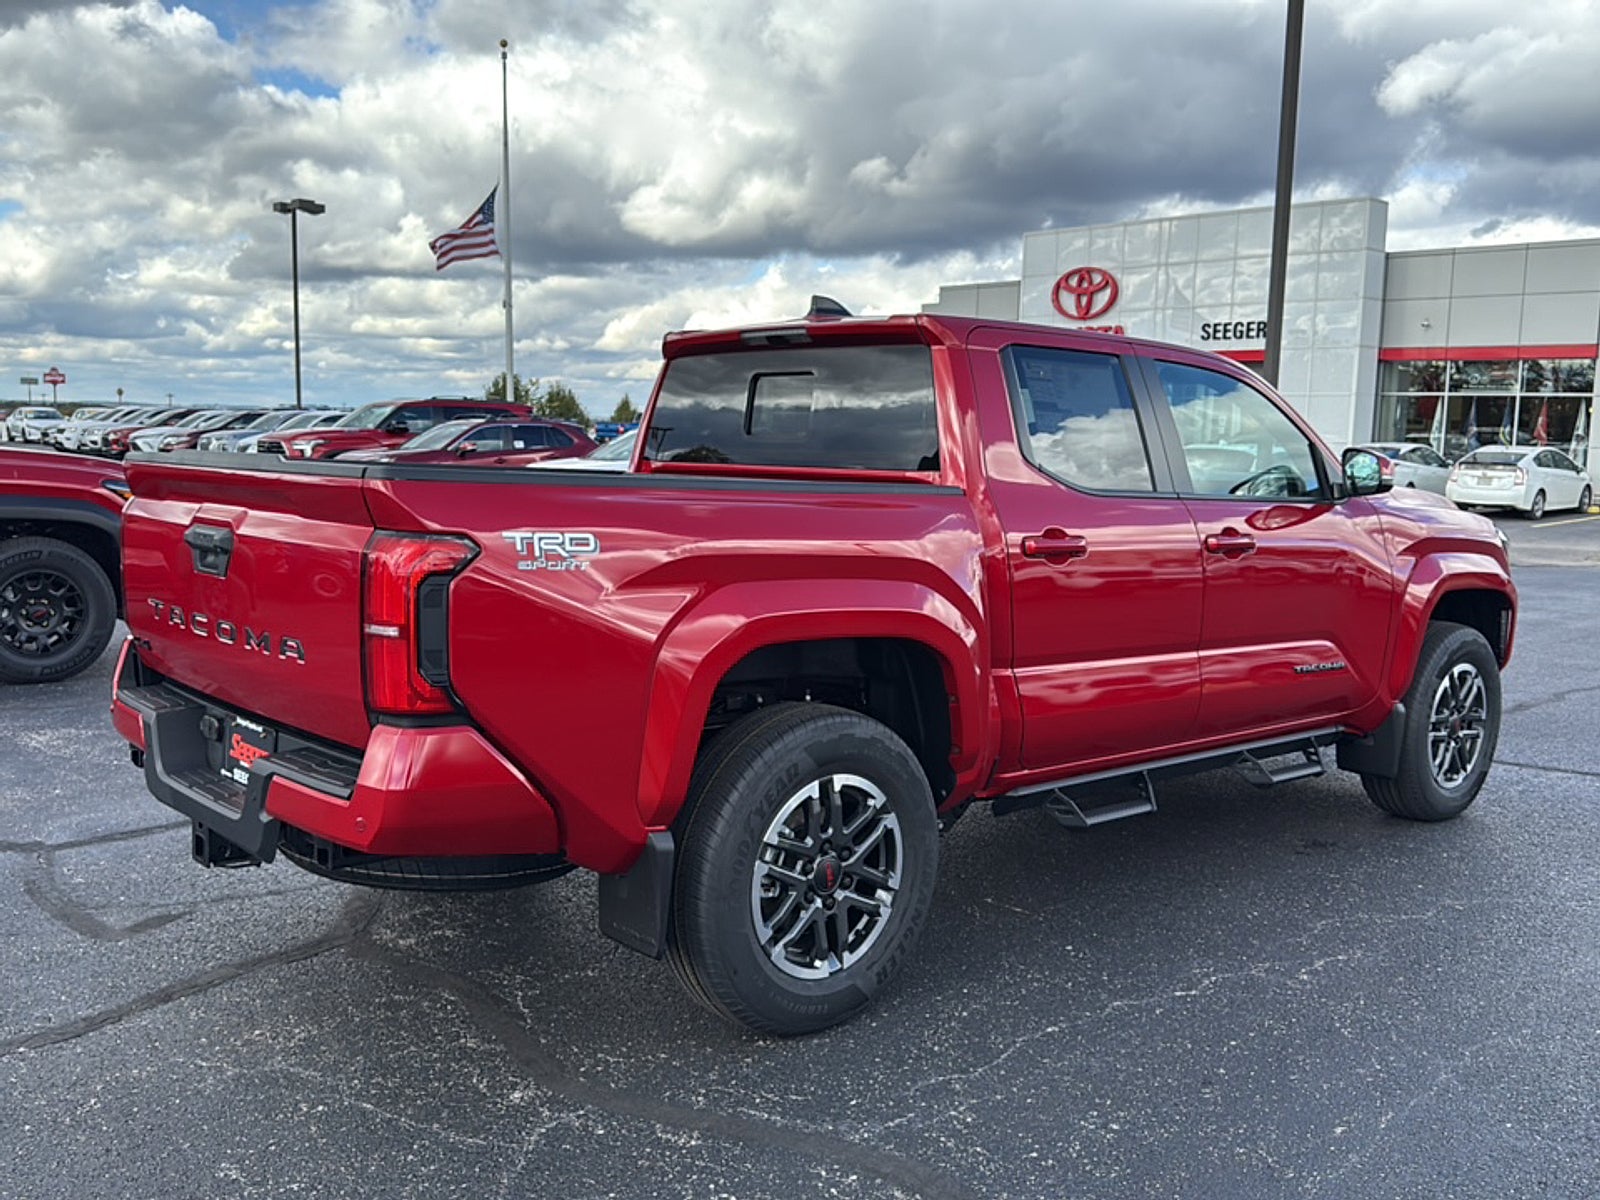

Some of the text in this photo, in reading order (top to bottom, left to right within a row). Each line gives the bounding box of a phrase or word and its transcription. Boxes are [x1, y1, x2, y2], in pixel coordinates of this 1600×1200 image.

[1200, 321, 1267, 341] SEEGER
[502, 531, 600, 557] TRD
[147, 598, 306, 665] TACOMA
[1293, 661, 1345, 674] TACOMA
